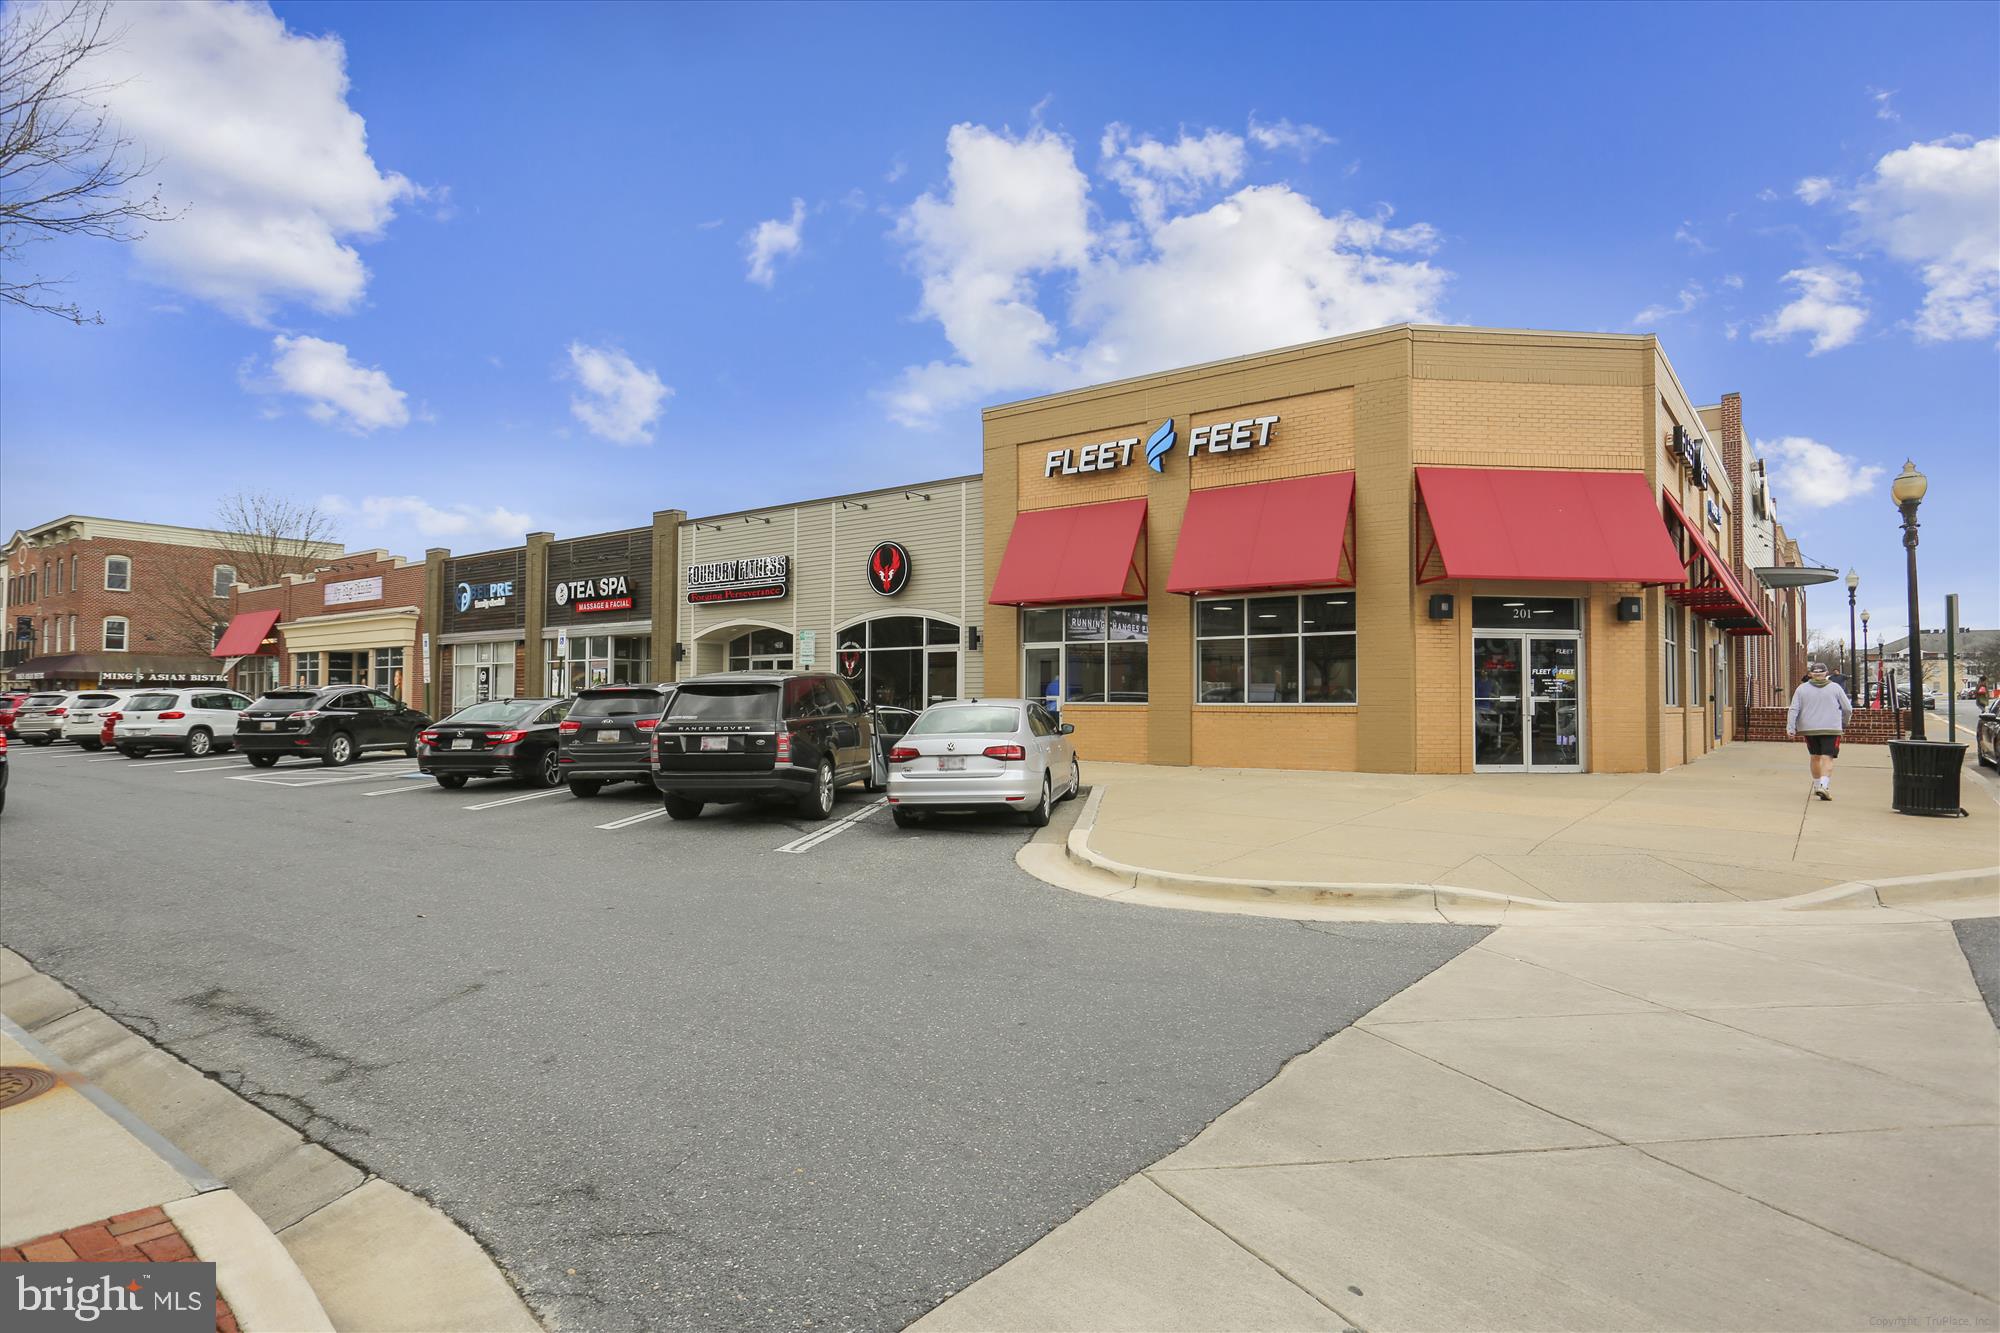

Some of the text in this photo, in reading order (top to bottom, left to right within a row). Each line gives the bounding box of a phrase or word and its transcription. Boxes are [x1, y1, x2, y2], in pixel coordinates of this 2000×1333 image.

[1044, 415, 1280, 478] FLEET FEET
[687, 554, 786, 586] FOUNDRY FITNESS
[568, 575, 627, 600] TEA SPA
[690, 588, 781, 602] Forging Perseverance
[578, 602, 604, 611] MASSAGE
[610, 600, 630, 608] FACIAL
[1513, 609, 1531, 618] 201
[1071, 617, 1105, 629] RUNNING
